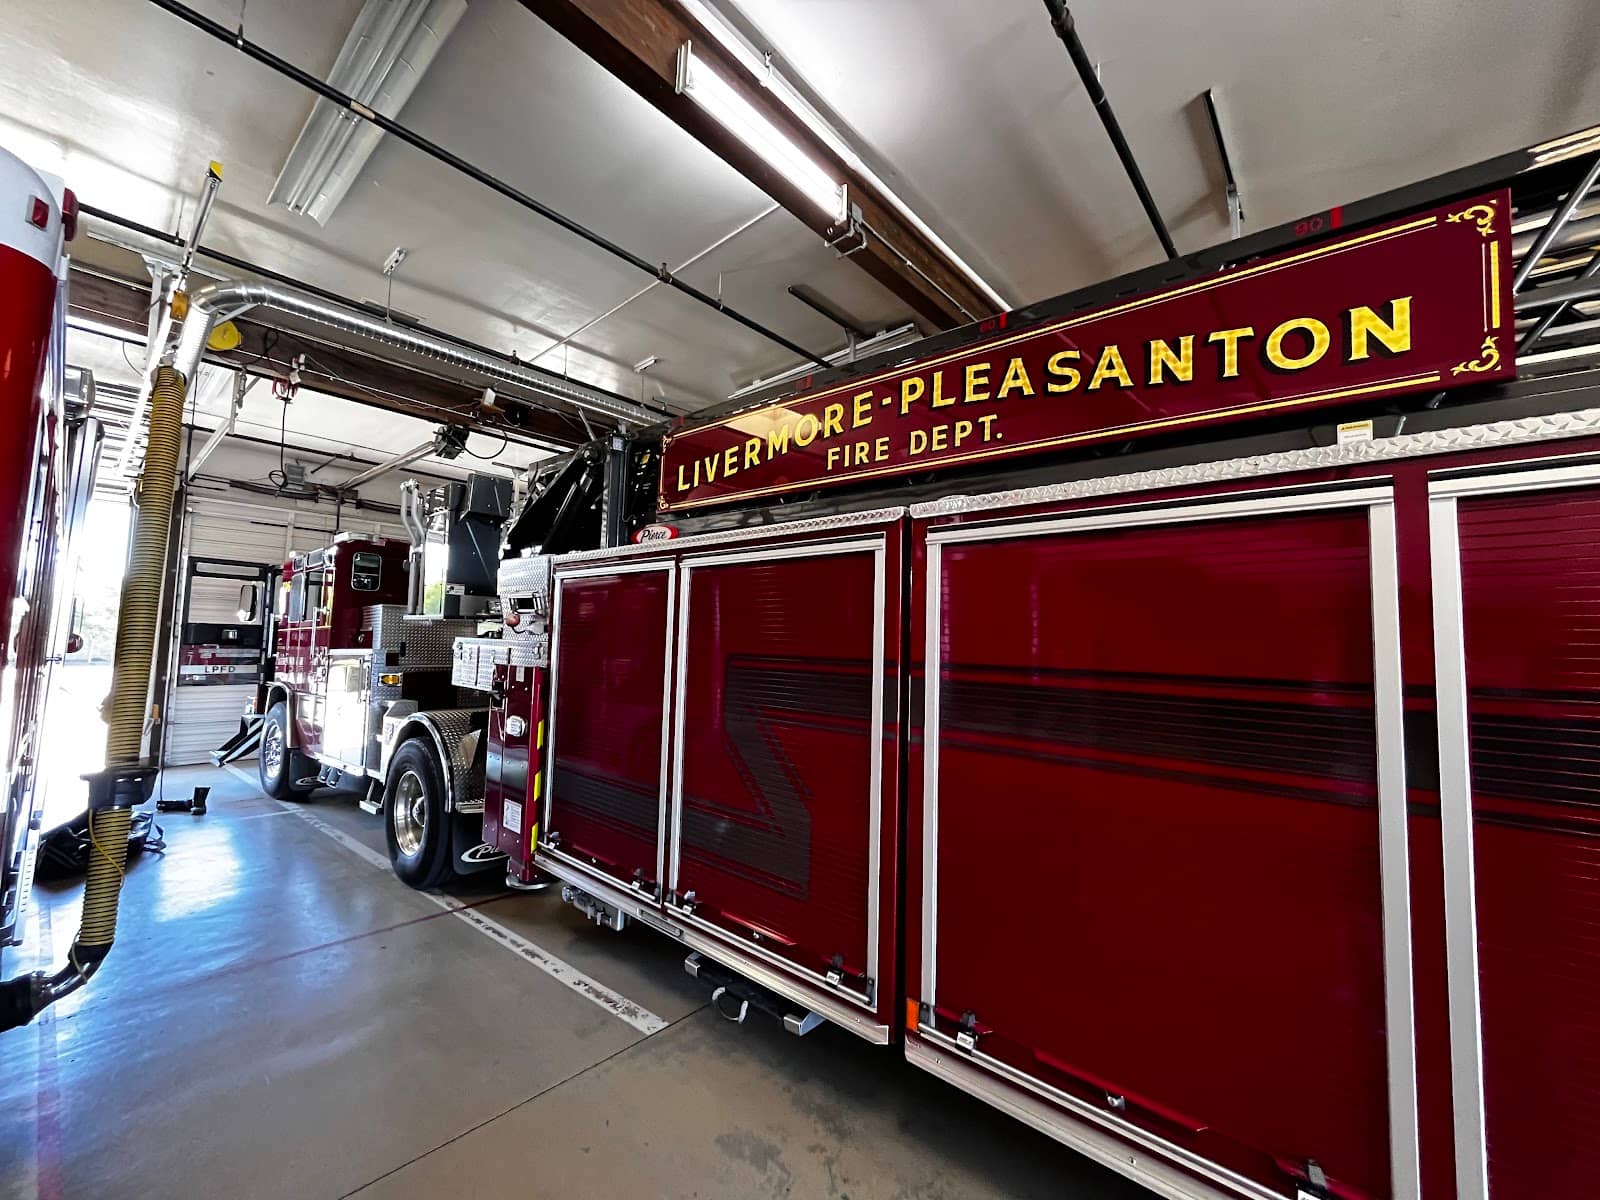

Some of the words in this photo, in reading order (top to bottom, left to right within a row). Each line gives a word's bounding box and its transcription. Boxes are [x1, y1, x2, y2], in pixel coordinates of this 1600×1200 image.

[678, 296, 1413, 492] LIVERMORE-PLEASANTON
[826, 437, 891, 471] FIRE
[909, 414, 1004, 456] DEPT.
[204, 665, 236, 673] LPFD
